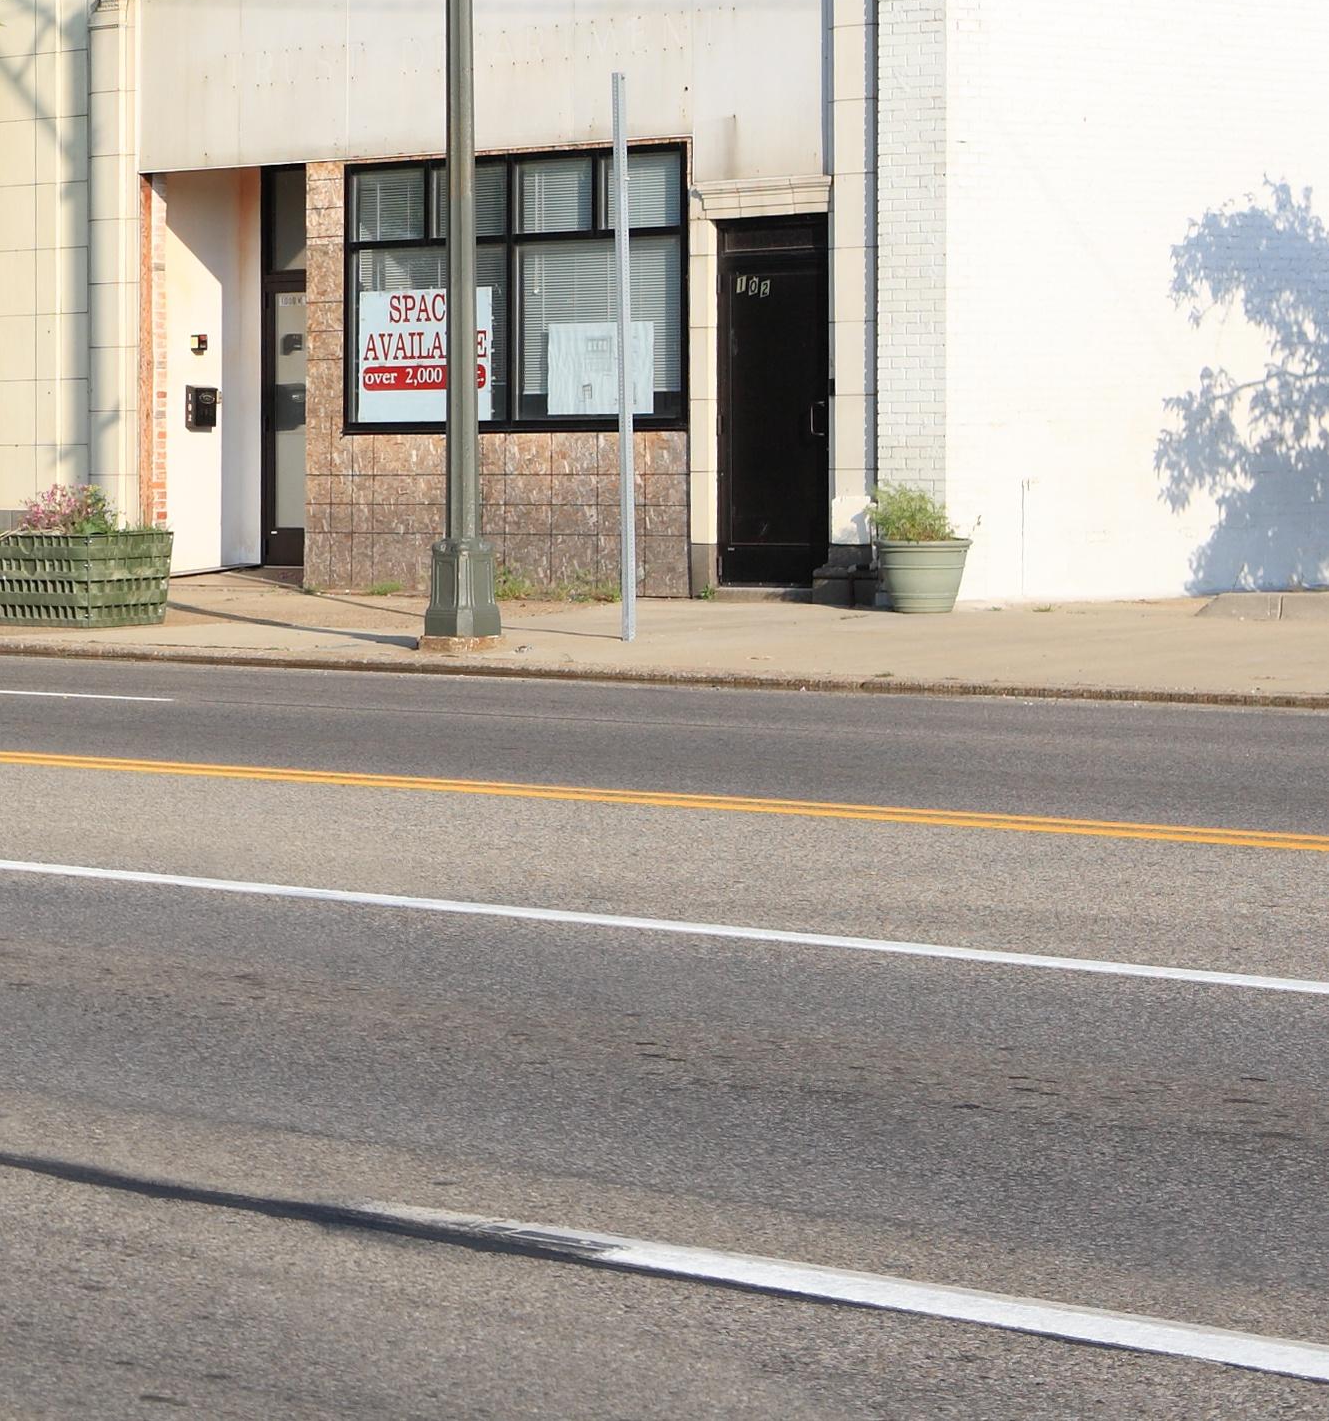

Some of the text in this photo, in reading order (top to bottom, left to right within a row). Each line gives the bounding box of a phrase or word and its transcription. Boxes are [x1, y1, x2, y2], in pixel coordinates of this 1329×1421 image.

[736, 276, 770, 297] 102
[389, 294, 446, 323] SPAC
[363, 329, 487, 361] AVAILAE
[365, 367, 443, 387] over 2,000
